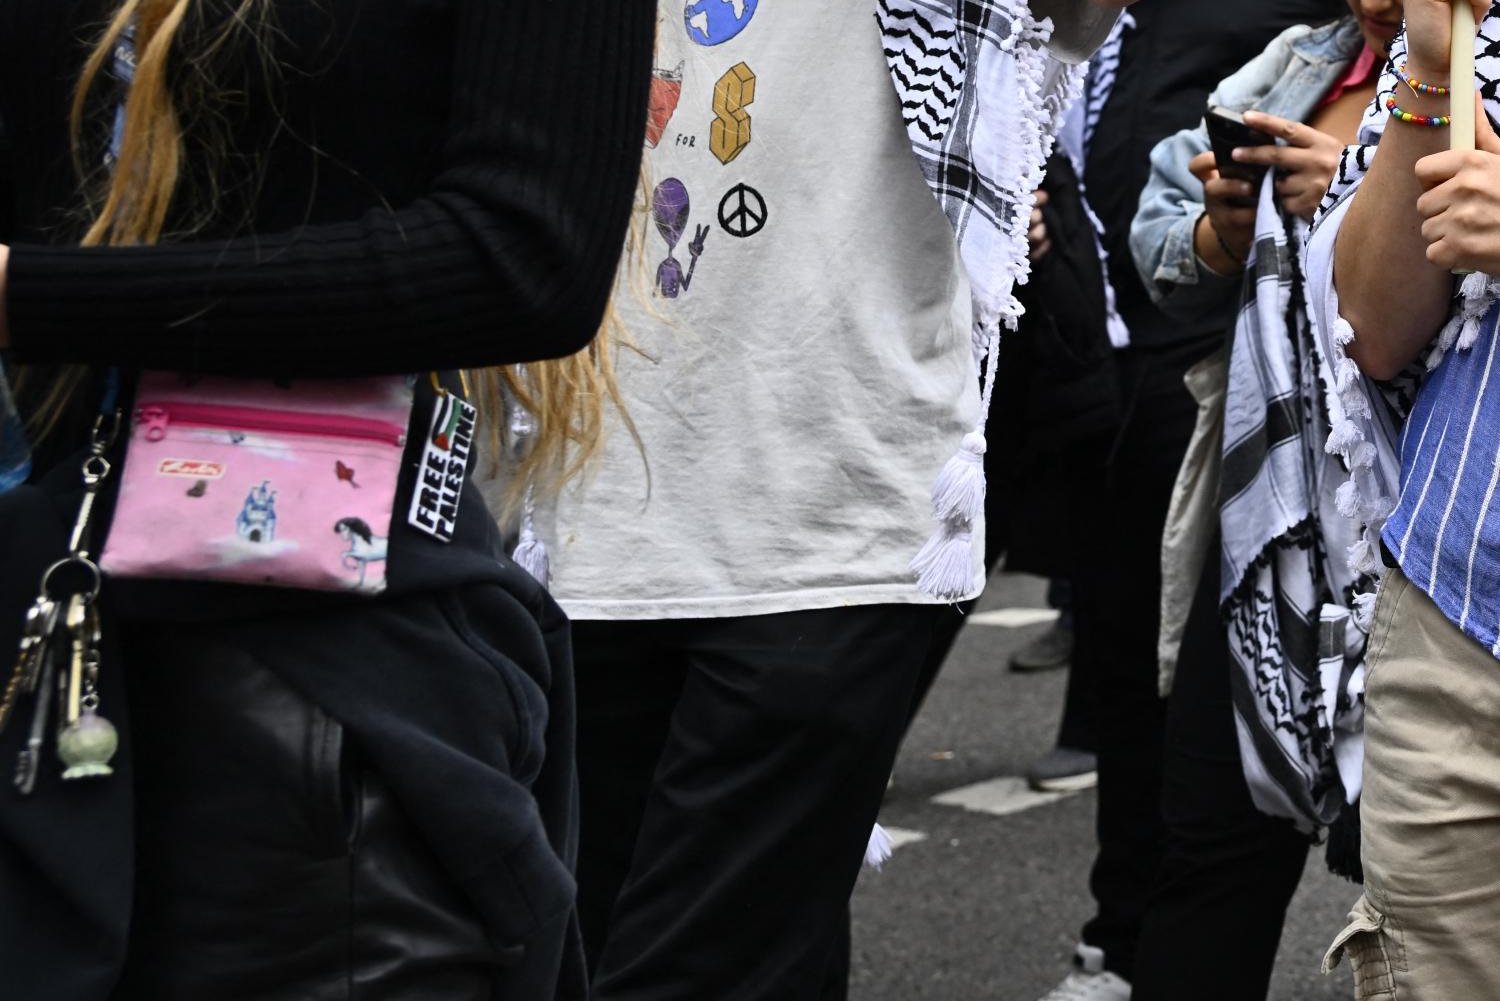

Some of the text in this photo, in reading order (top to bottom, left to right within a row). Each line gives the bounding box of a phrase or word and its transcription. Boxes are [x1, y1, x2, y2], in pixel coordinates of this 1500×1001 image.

[675, 133, 696, 148] FOR
[416, 451, 447, 530] FREE
[433, 402, 477, 538] PALESTINE
